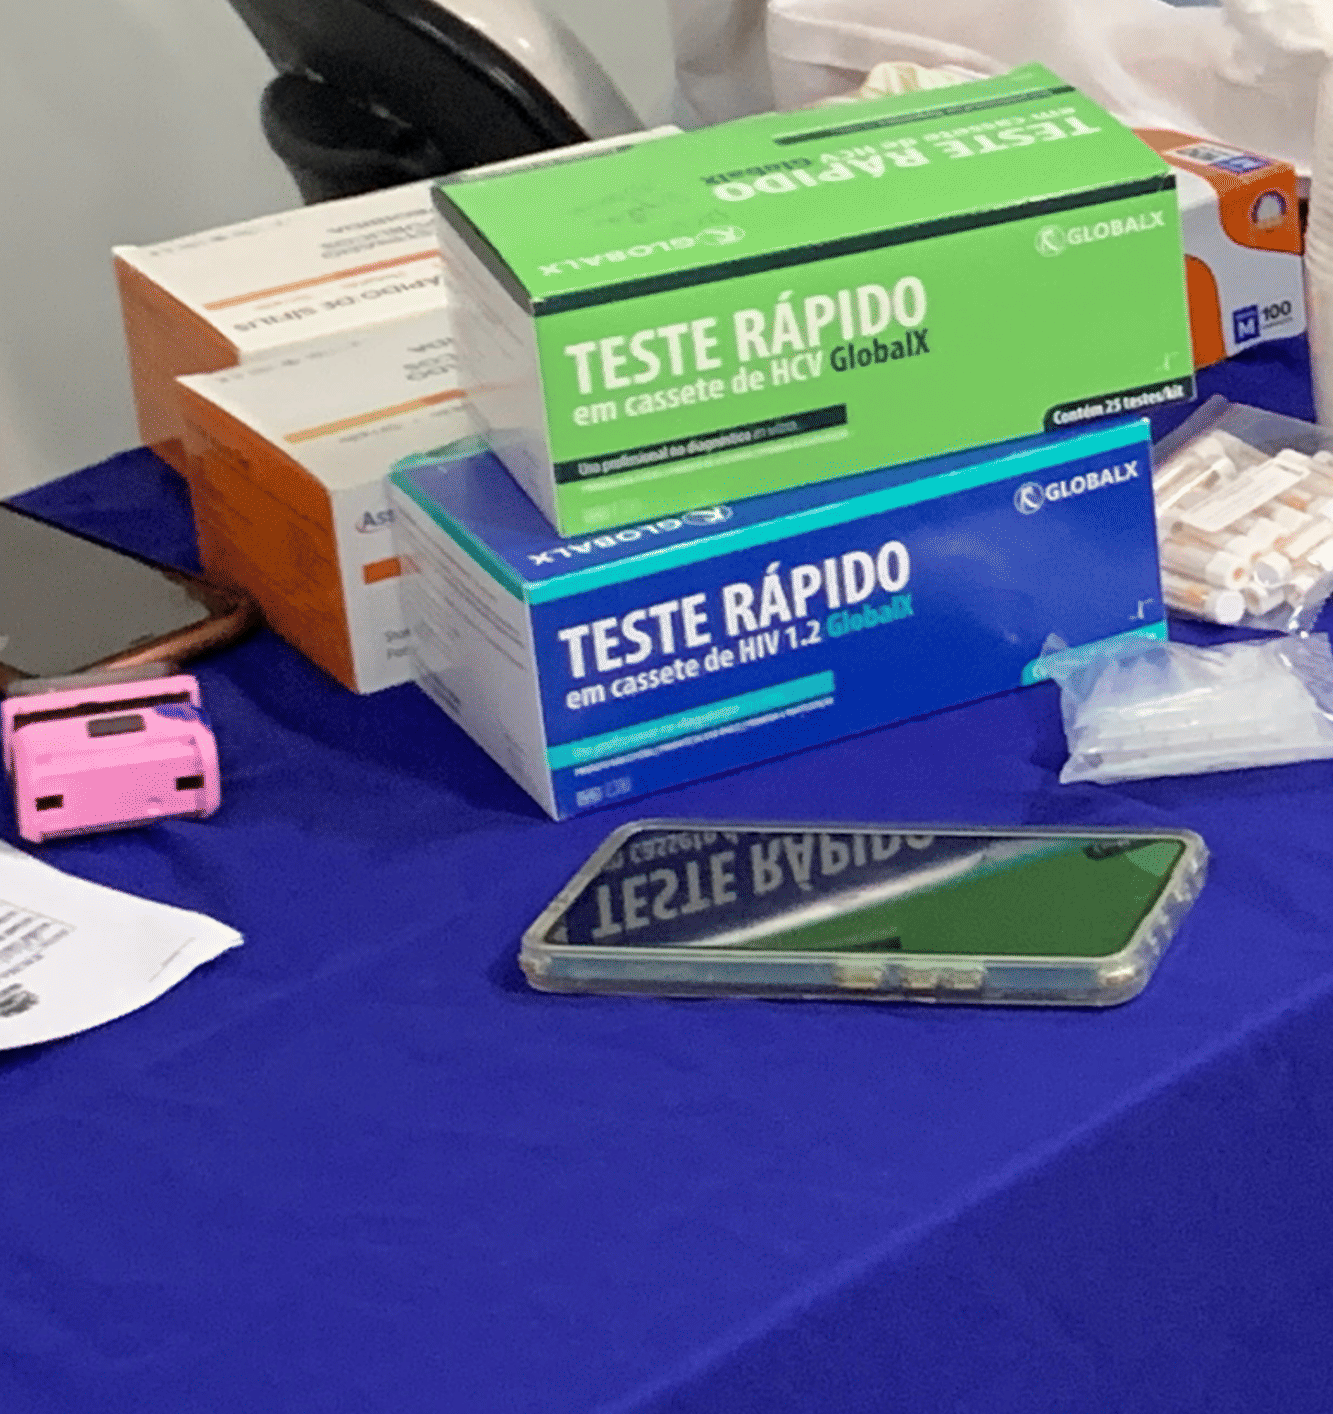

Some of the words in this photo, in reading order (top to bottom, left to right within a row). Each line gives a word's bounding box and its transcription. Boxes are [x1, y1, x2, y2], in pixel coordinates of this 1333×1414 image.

[934, 116, 1101, 160] TESTE
[713, 146, 930, 201] RÁPIDO
[1066, 210, 1166, 246] GLOBALX
[538, 236, 696, 276] GLOBALX
[1262, 300, 1292, 321] 100
[564, 316, 722, 395] TESTE
[733, 275, 927, 362] RÁPIDO
[573, 401, 617, 427] em
[624, 378, 725, 418] cassete
[731, 366, 765, 395] de
[771, 350, 823, 386] HCV
[829, 327, 930, 373] GlobalX
[1053, 404, 1104, 425] Contém
[1105, 398, 1122, 414] 25
[1123, 384, 1185, 410] testes/kit
[1045, 460, 1138, 501] GLOBALX
[527, 518, 683, 565] GLOBALX
[557, 592, 711, 679] TESTE
[722, 540, 911, 637] RÁPIDO
[565, 684, 606, 710] em
[610, 658, 700, 698] cassete
[704, 646, 735, 672] de
[738, 629, 780, 664] HIV
[784, 619, 823, 649] 1.2
[826, 592, 915, 638] GlobalX
